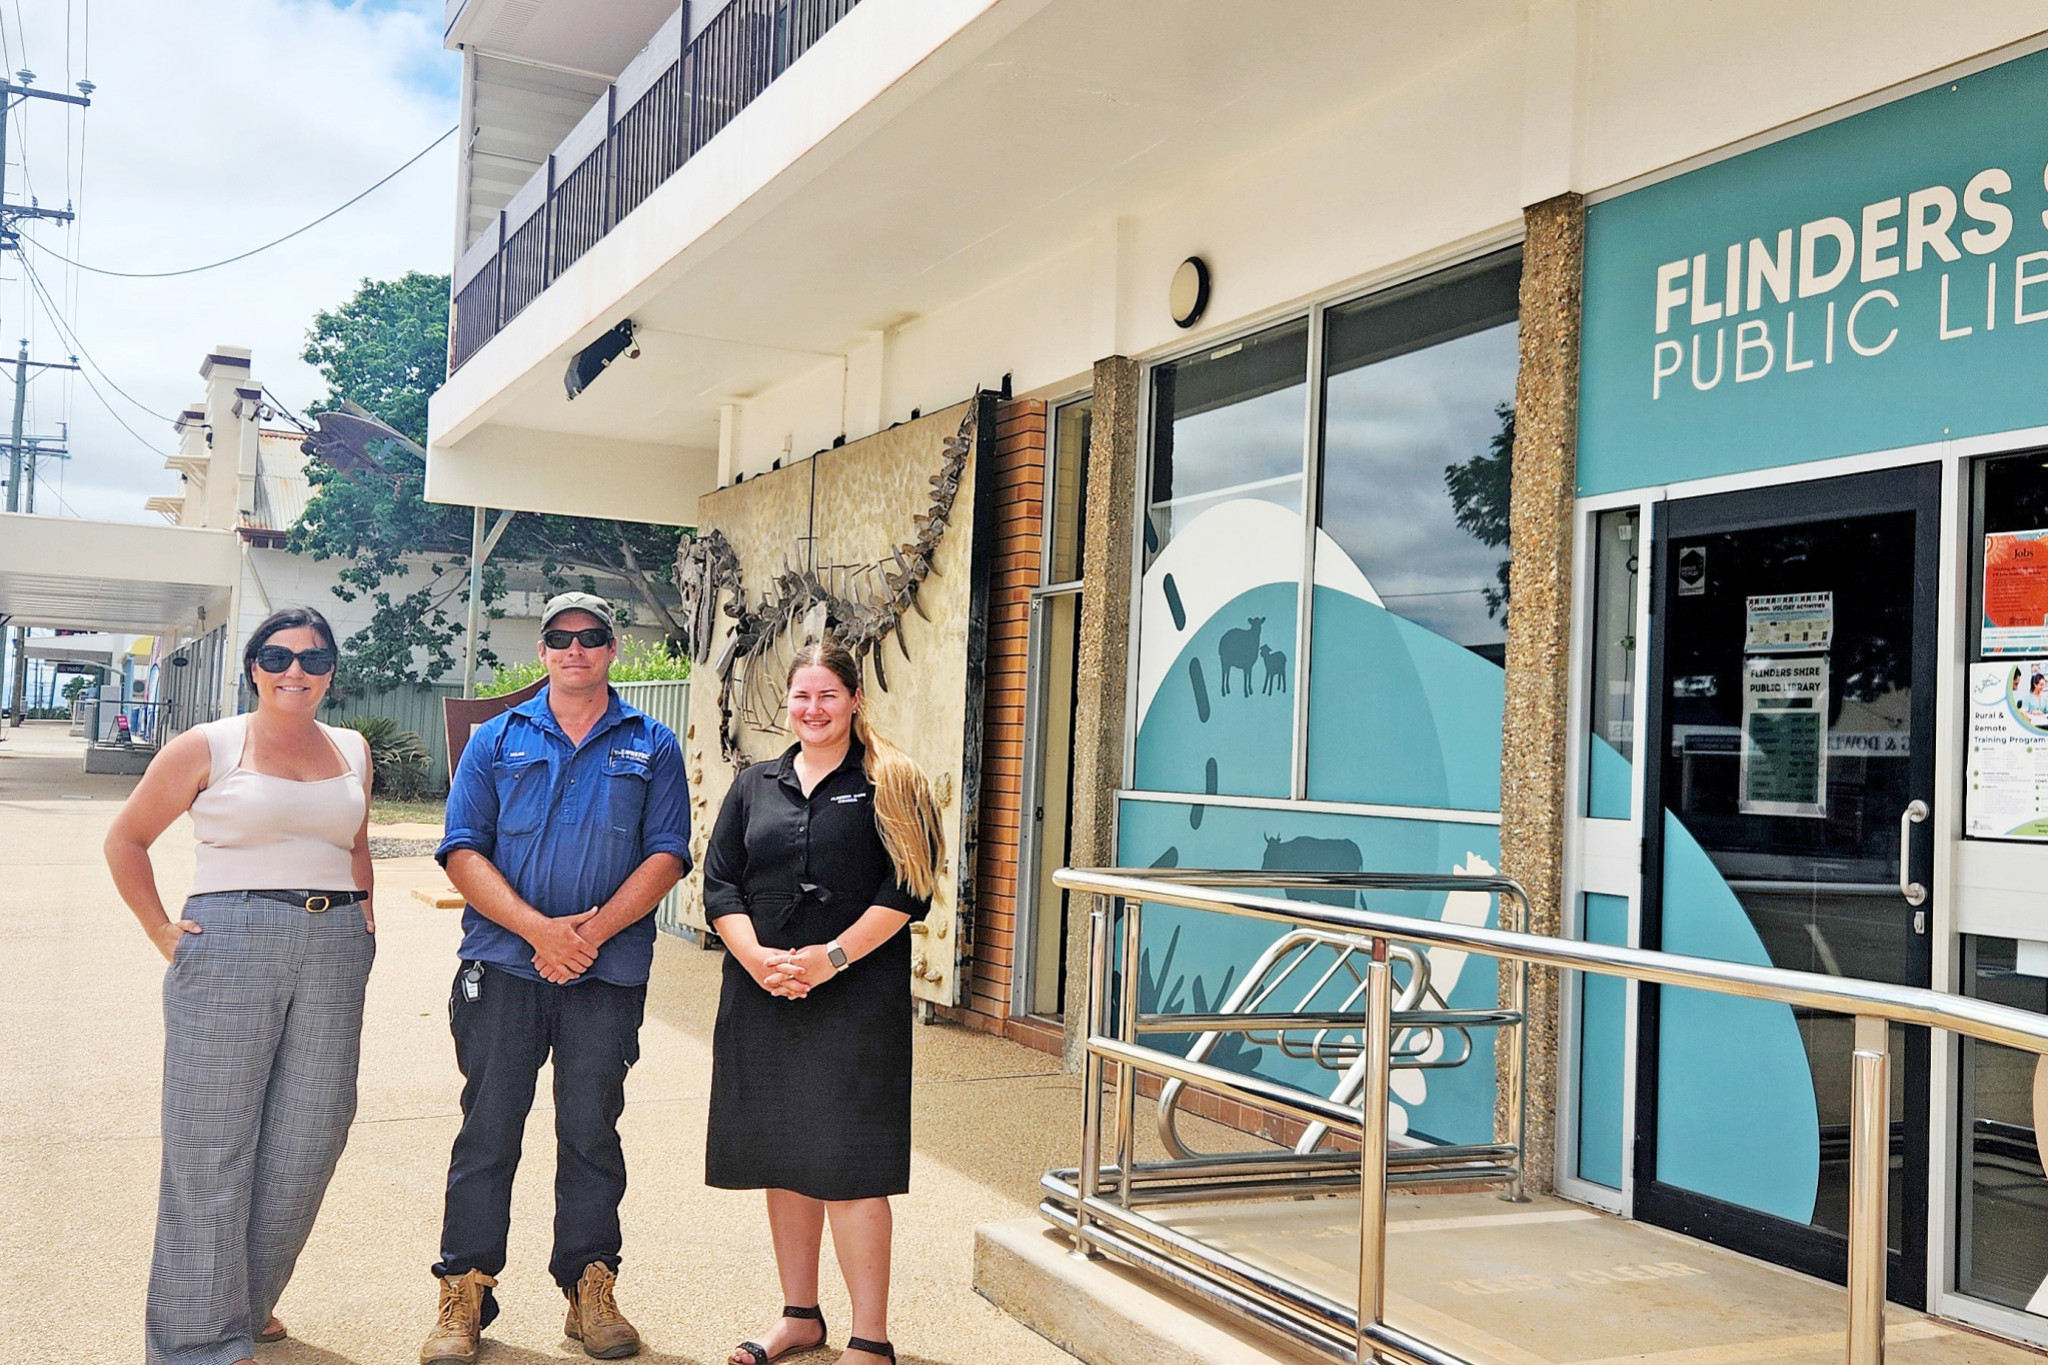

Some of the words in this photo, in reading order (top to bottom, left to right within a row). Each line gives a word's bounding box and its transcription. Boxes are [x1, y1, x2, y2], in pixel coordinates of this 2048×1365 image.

[1655, 168, 2013, 334] FLINDERS
[1653, 289, 1899, 400] PUBLIC
[2012, 548, 2034, 559] Jobs
[1751, 667, 1792, 678] FLINDERS
[1794, 667, 1820, 676] SHIRE
[1750, 684, 1781, 693] PUBLIC
[1783, 682, 1821, 692] LIBRARY
[1975, 711, 1996, 719] Rural
[1998, 711, 2004, 719] &
[1974, 724, 2007, 732] Remote
[1974, 735, 2007, 744] Training
[2009, 736, 2046, 745] Program
[1565, 1262, 1710, 1285] CLEAR
